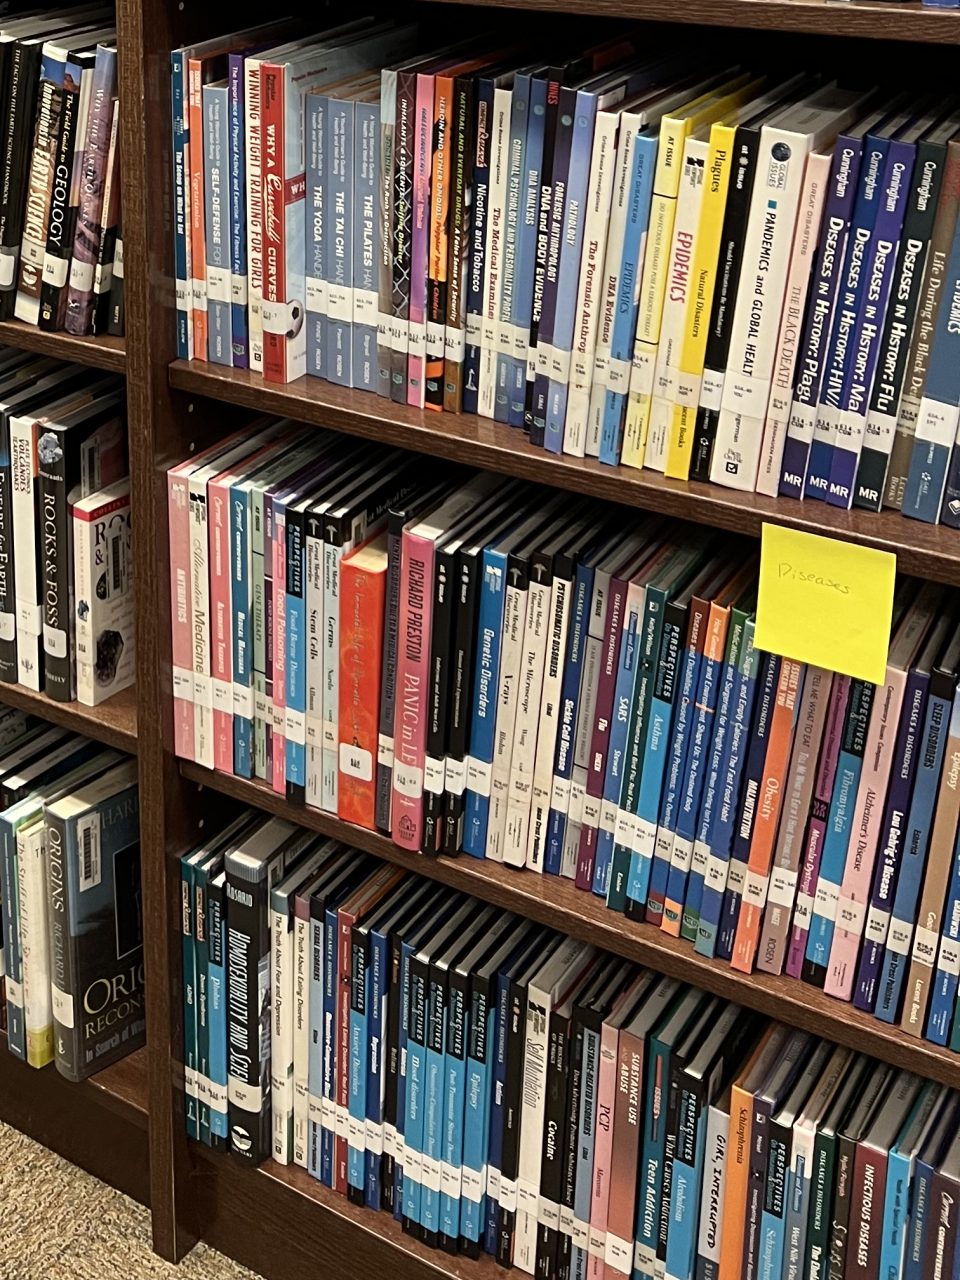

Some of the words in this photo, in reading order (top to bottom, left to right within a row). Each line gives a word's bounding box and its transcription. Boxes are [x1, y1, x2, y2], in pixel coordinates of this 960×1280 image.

[248, 70, 260, 121] WINNING
[266, 124, 275, 152] WHY
[710, 150, 727, 192] Plagues
[836, 148, 854, 198] Cunningham
[50, 165, 69, 247] GEOLOGY
[212, 167, 221, 243] SELF-DEFENSE
[474, 183, 487, 225] Nicotine
[540, 186, 552, 210] DNA
[313, 206, 323, 241] YOGA
[364, 217, 373, 266] PILATES
[760, 212, 777, 271] PANDEMICS
[266, 247, 277, 302] CURVES
[472, 248, 481, 292] Tobacco
[670, 231, 693, 303] EPIDEMICS
[748, 297, 764, 340] GLOBAL
[877, 382, 894, 411] Flu
[43, 494, 56, 563] ROCKS
[481, 629, 495, 669] Genetic
[476, 671, 491, 718] Disorders
[48, 827, 64, 912] ORIGINS
[599, 1104, 610, 1131] PCP
